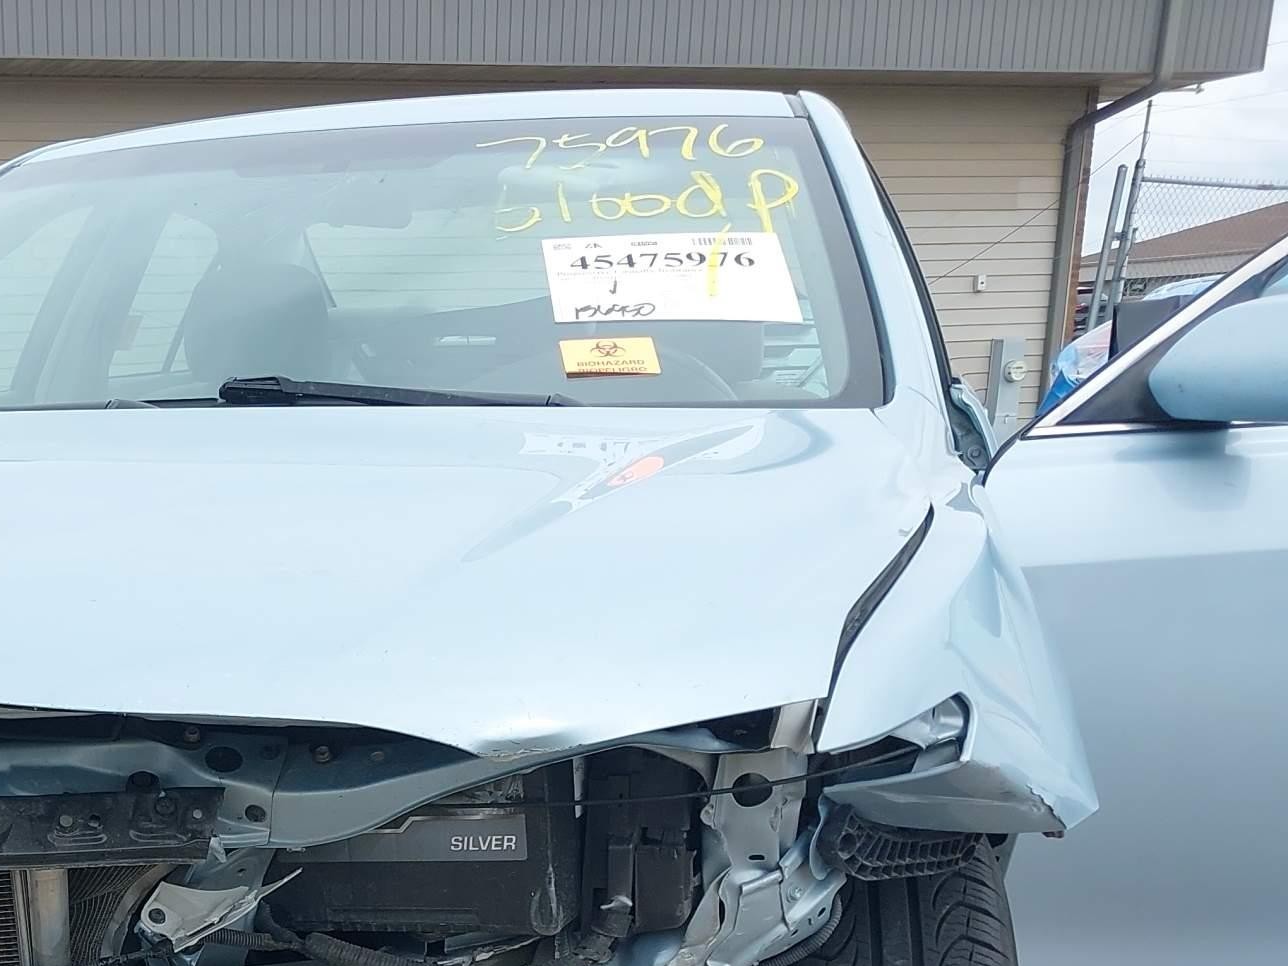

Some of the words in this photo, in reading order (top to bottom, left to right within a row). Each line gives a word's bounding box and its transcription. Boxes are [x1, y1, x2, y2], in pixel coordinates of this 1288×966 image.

[475, 124, 764, 170] 75976
[569, 251, 756, 270] 45475976
[576, 359, 645, 367] BIOHAZARD
[450, 835, 517, 851] SILVER
